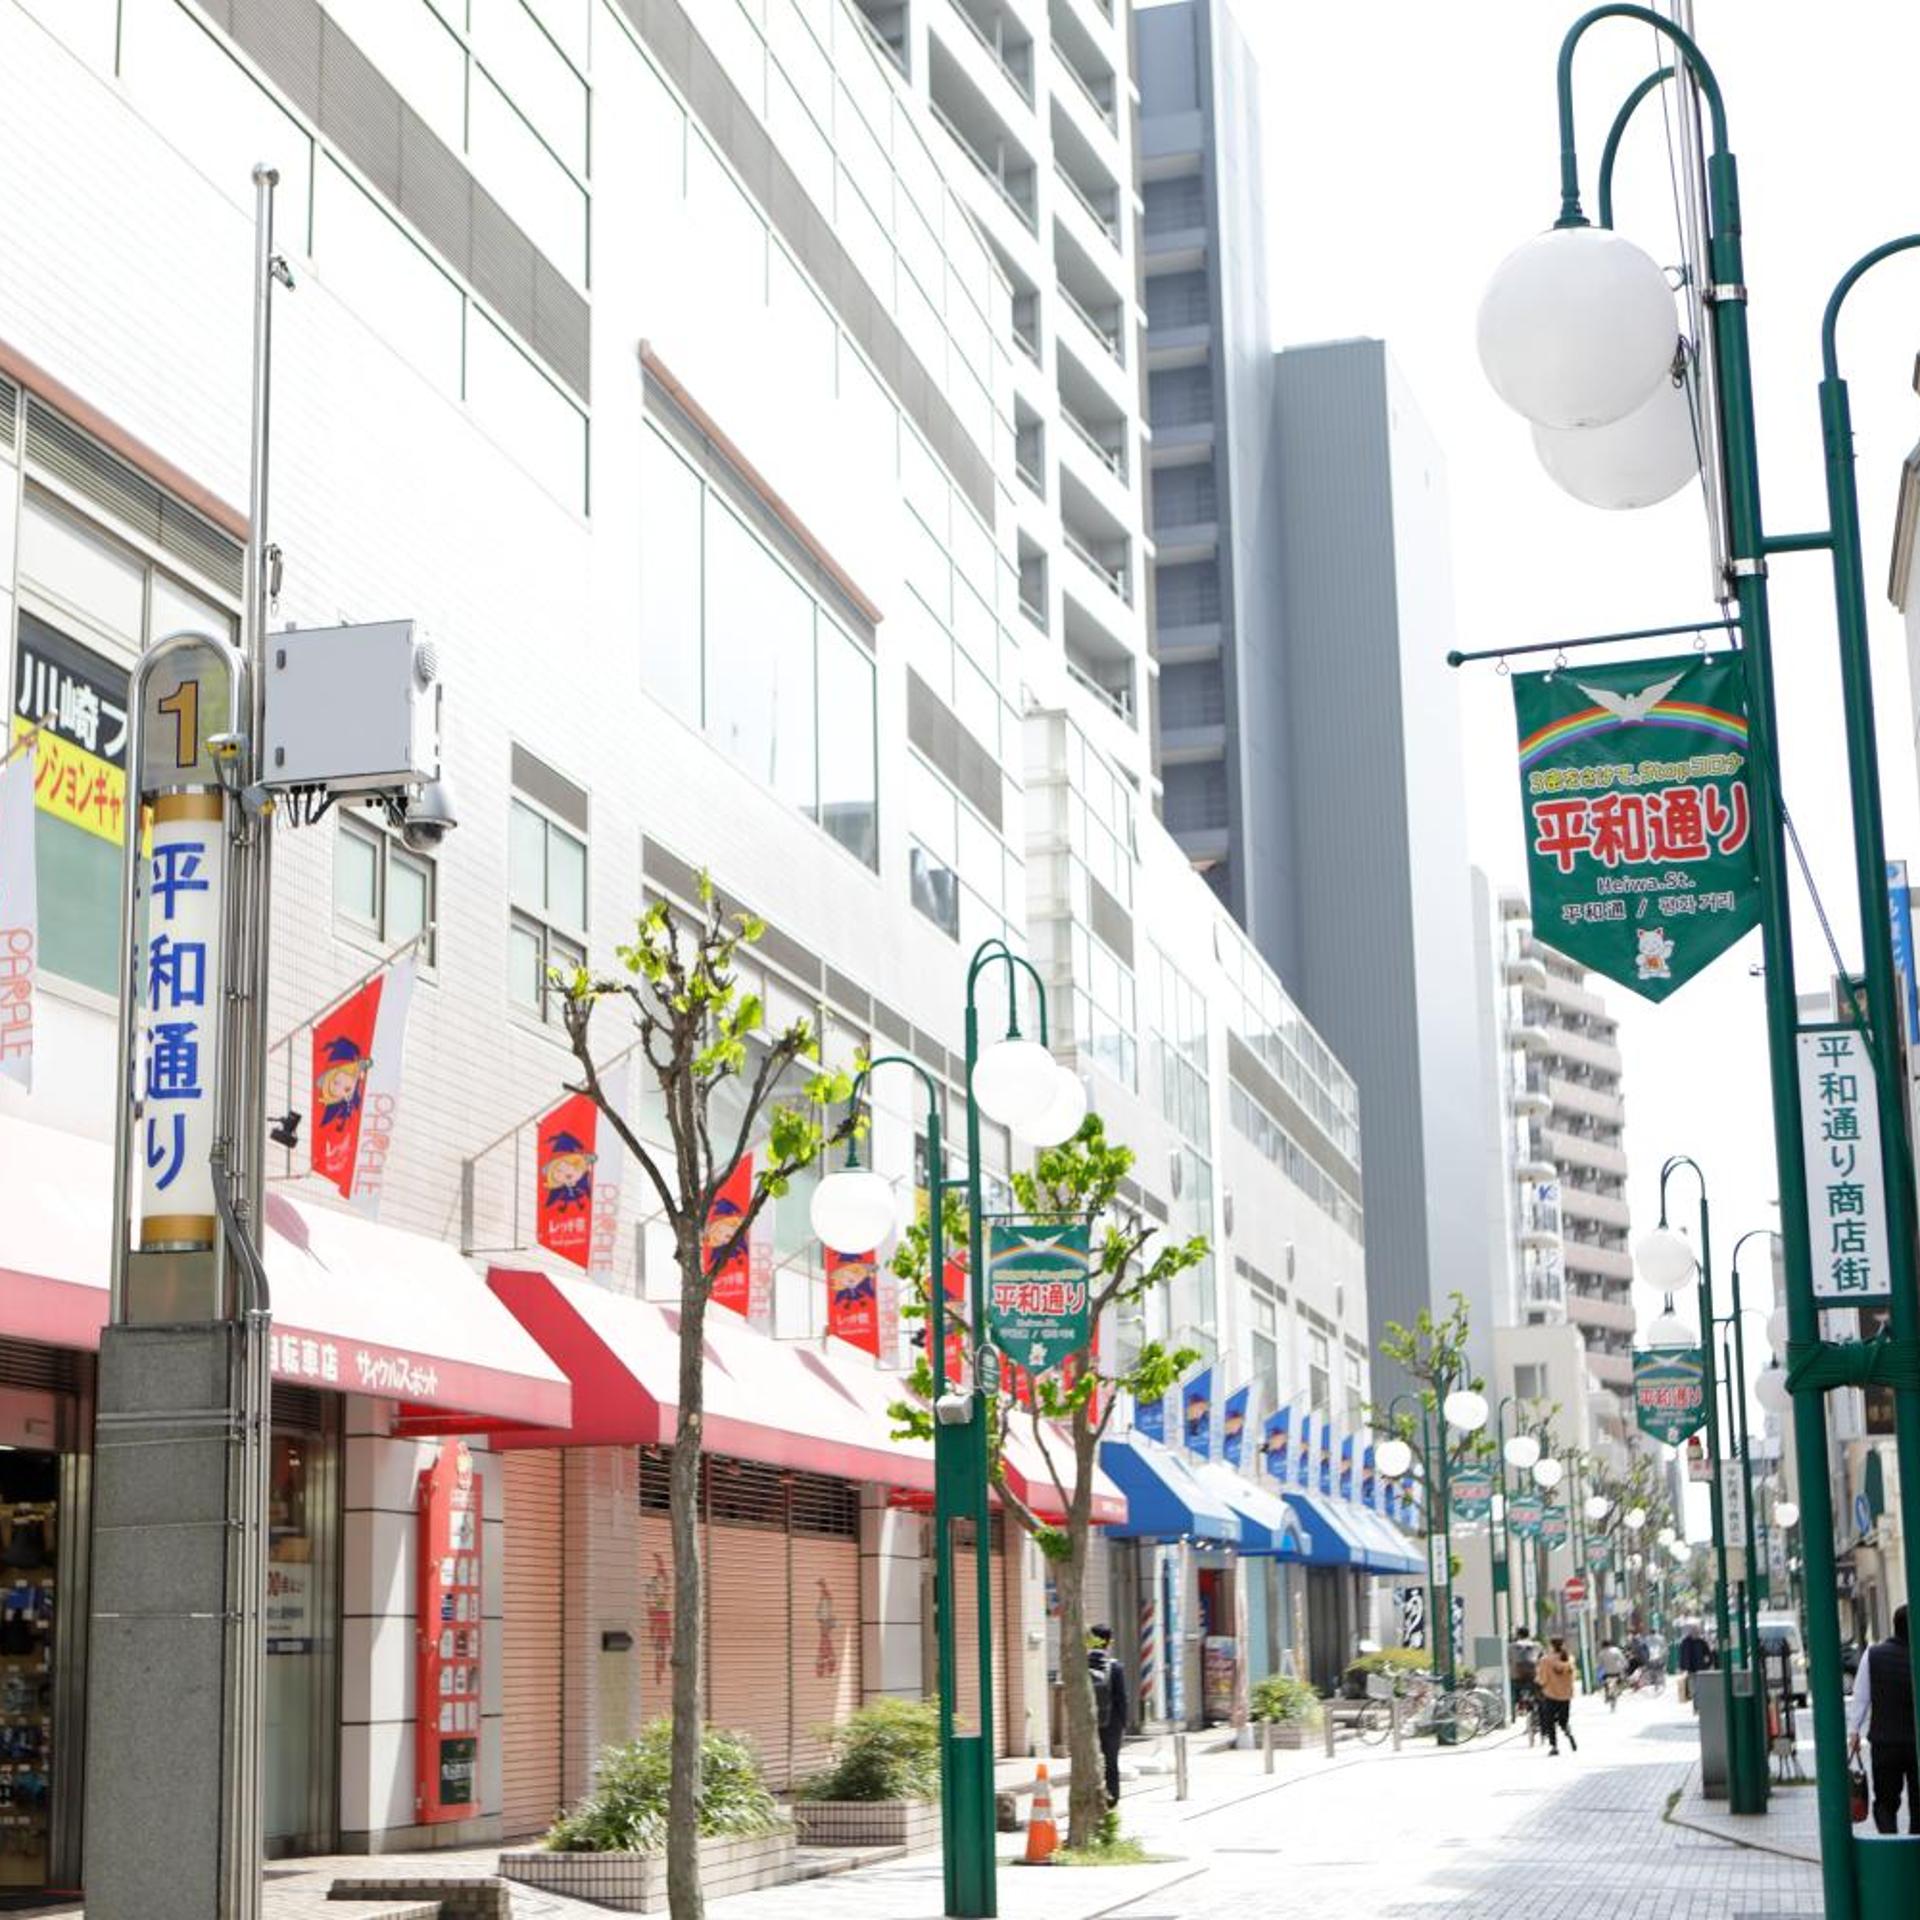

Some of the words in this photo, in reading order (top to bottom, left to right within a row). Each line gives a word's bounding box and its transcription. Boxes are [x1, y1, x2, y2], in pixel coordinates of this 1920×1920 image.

[158, 680, 199, 768] 1
[1533, 781, 1750, 874] 平和通り
[1562, 899, 1627, 923] 平和通
[147, 842, 210, 1192] 平和通り
[1816, 1035, 1871, 1293] 平和通り商店街
[992, 1282, 1087, 1316] 平和通り
